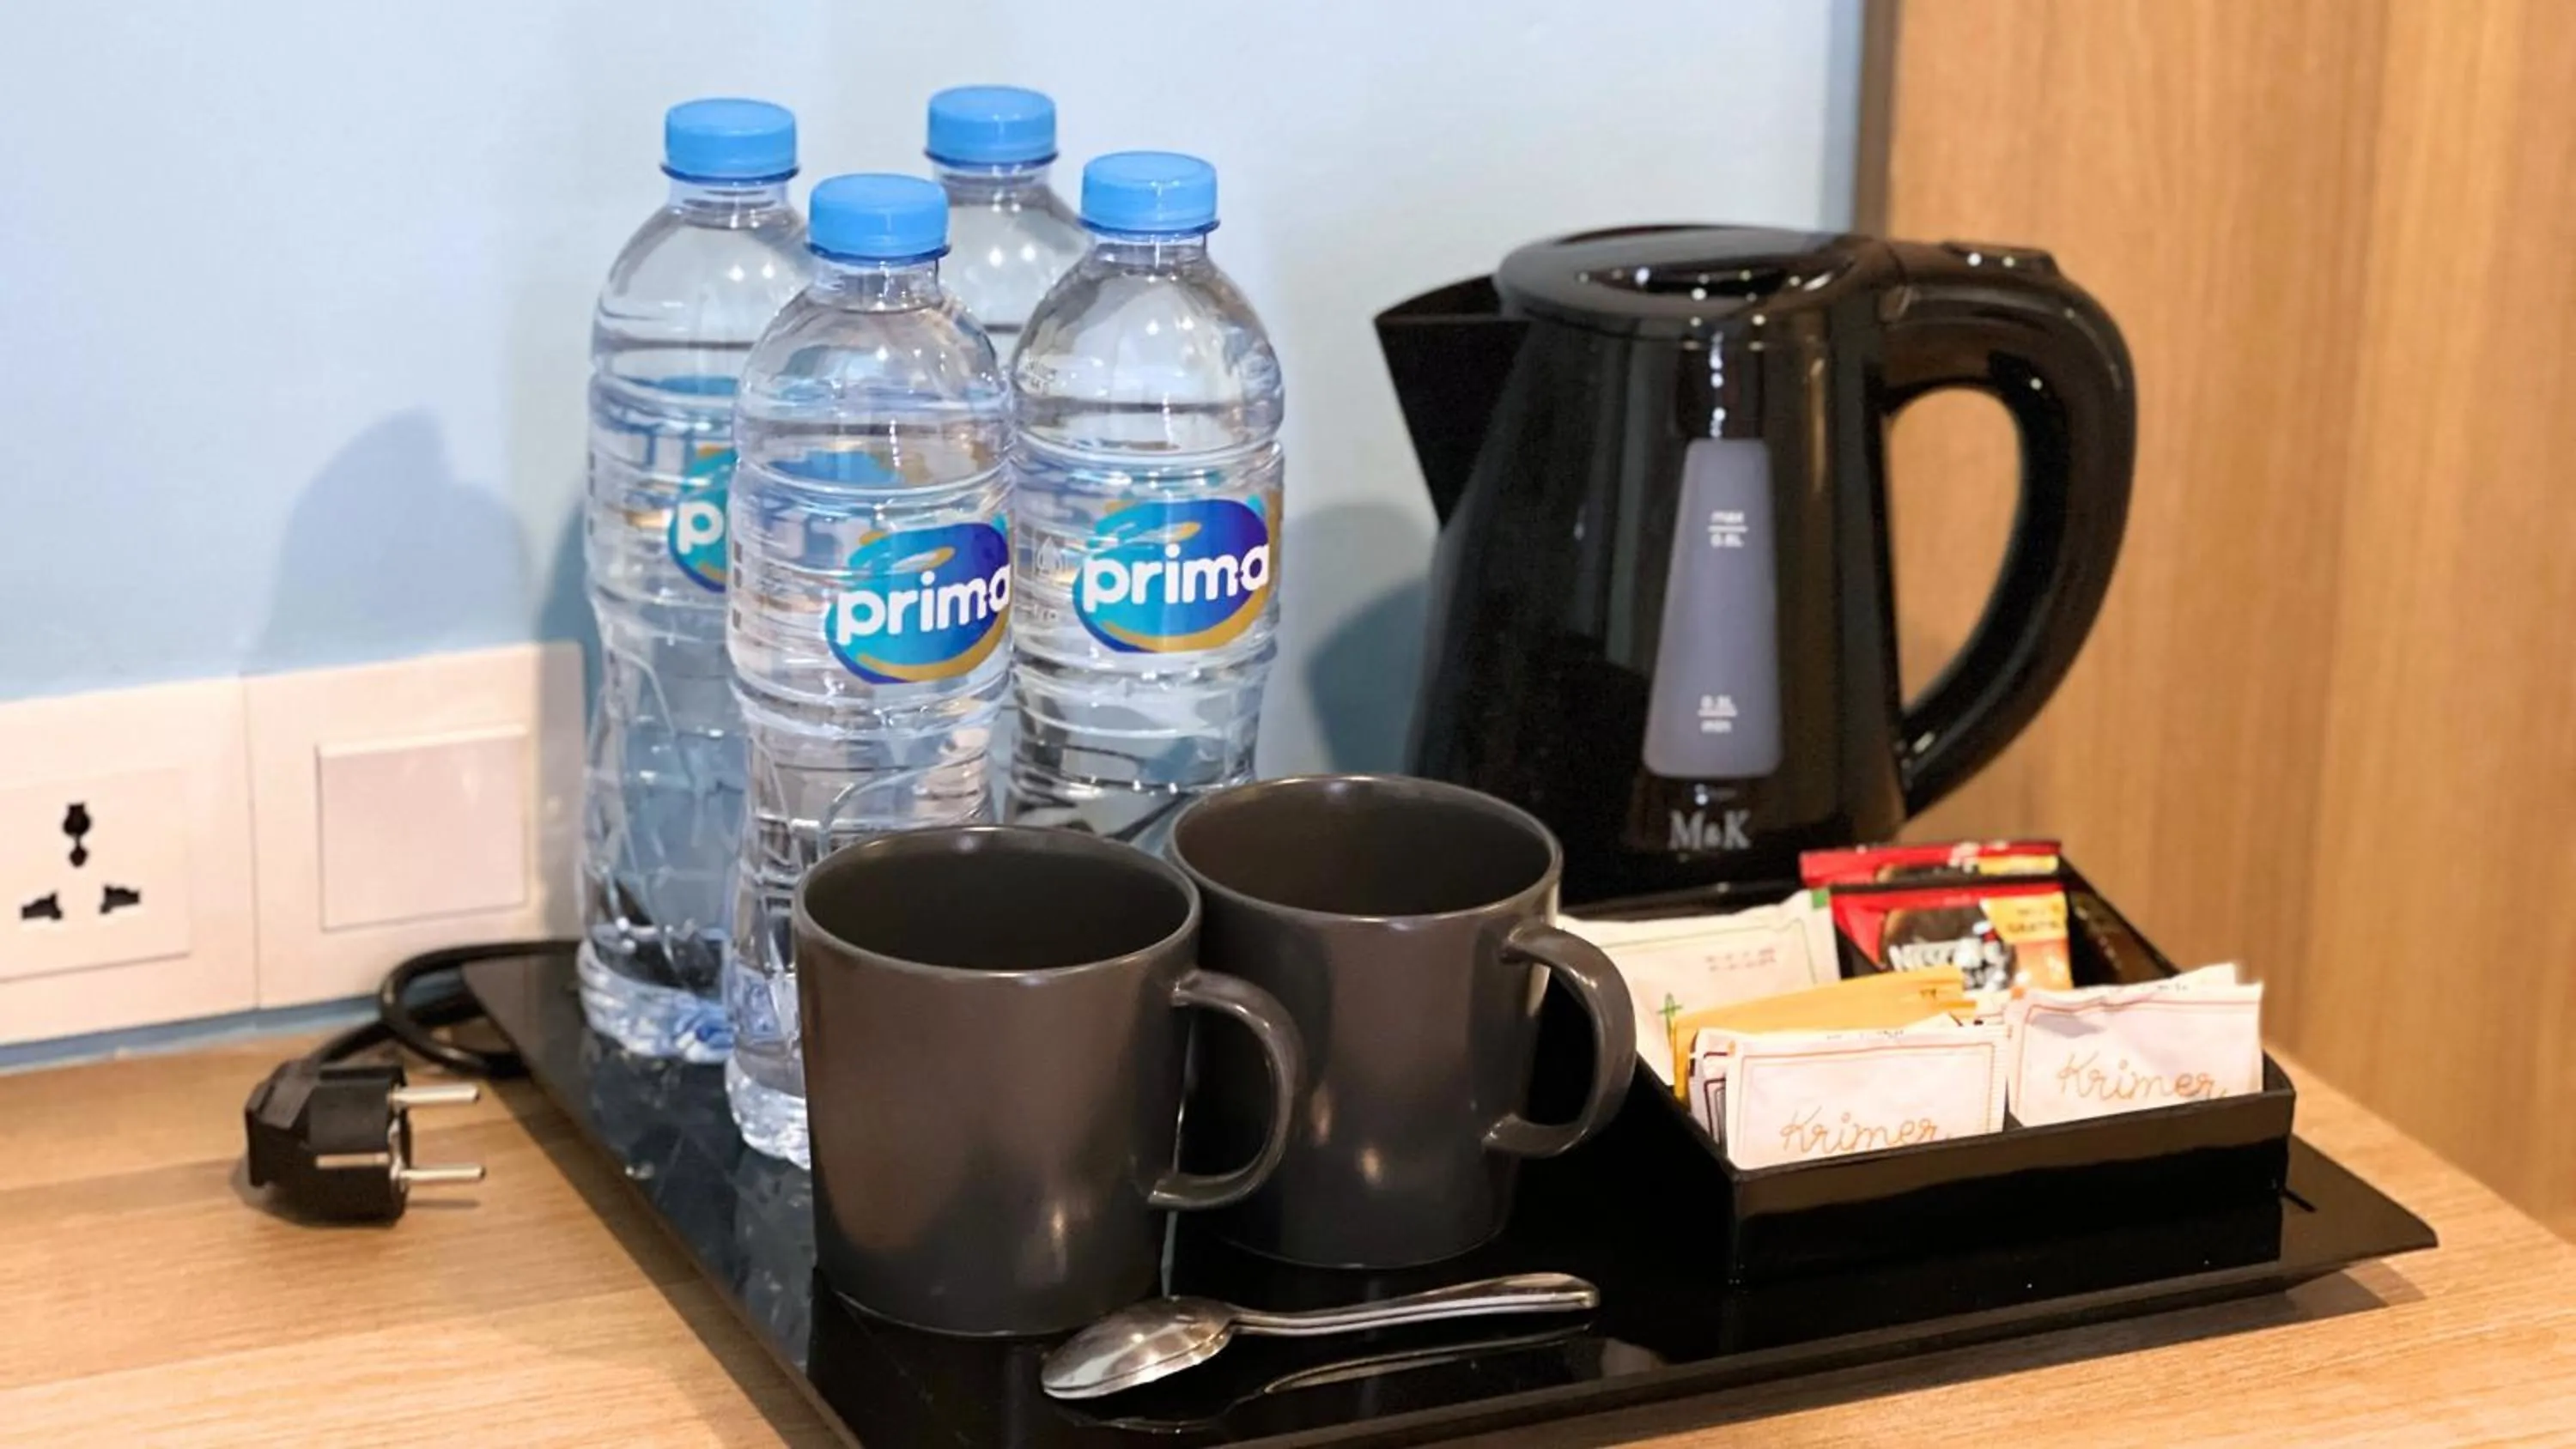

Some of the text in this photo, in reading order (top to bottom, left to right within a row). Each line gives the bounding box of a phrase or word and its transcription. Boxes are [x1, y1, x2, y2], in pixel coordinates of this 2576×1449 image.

[836, 564, 1012, 646] prima
[1083, 543, 1270, 612] prima
[2057, 1051, 2215, 1100] Krimer
[1779, 1105, 1938, 1155] Krimer
